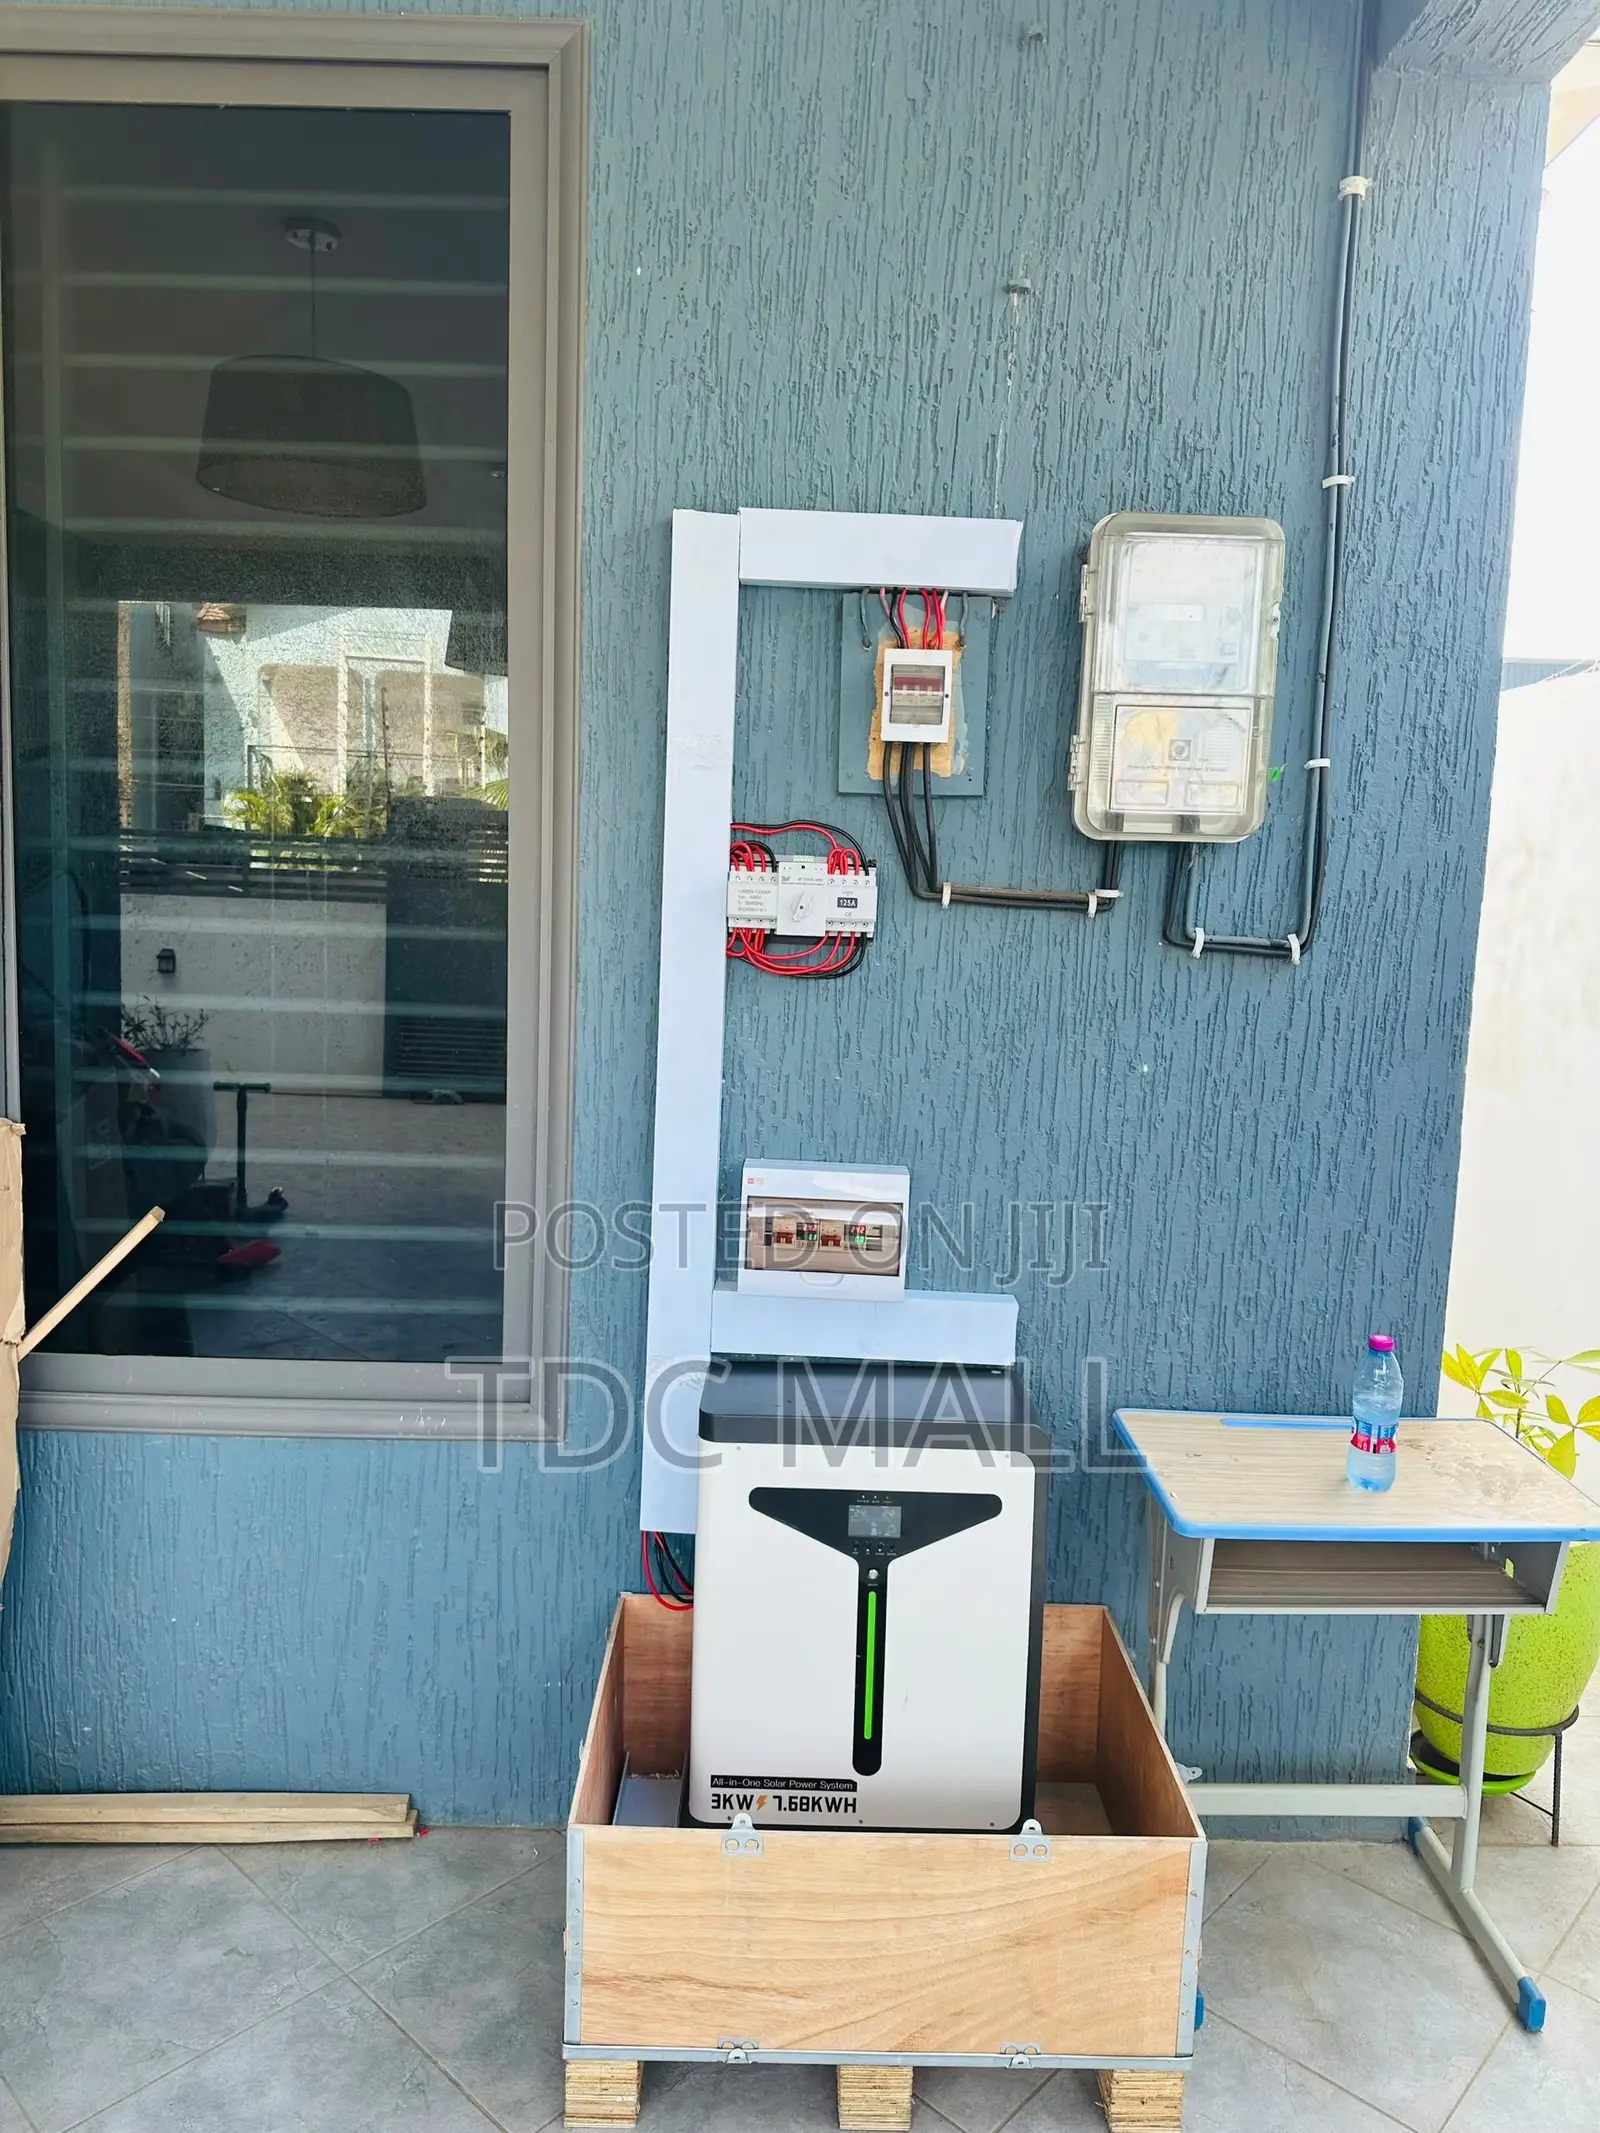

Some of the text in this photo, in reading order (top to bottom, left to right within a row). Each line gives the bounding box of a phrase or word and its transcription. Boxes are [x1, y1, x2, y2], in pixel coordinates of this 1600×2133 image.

[839, 898, 856, 907] 125A
[763, 1779, 786, 1788] Solar
[789, 1780, 816, 1789] Power
[820, 1781, 853, 1791] System
[711, 1793, 857, 1813] 3KW 7.68KWH
